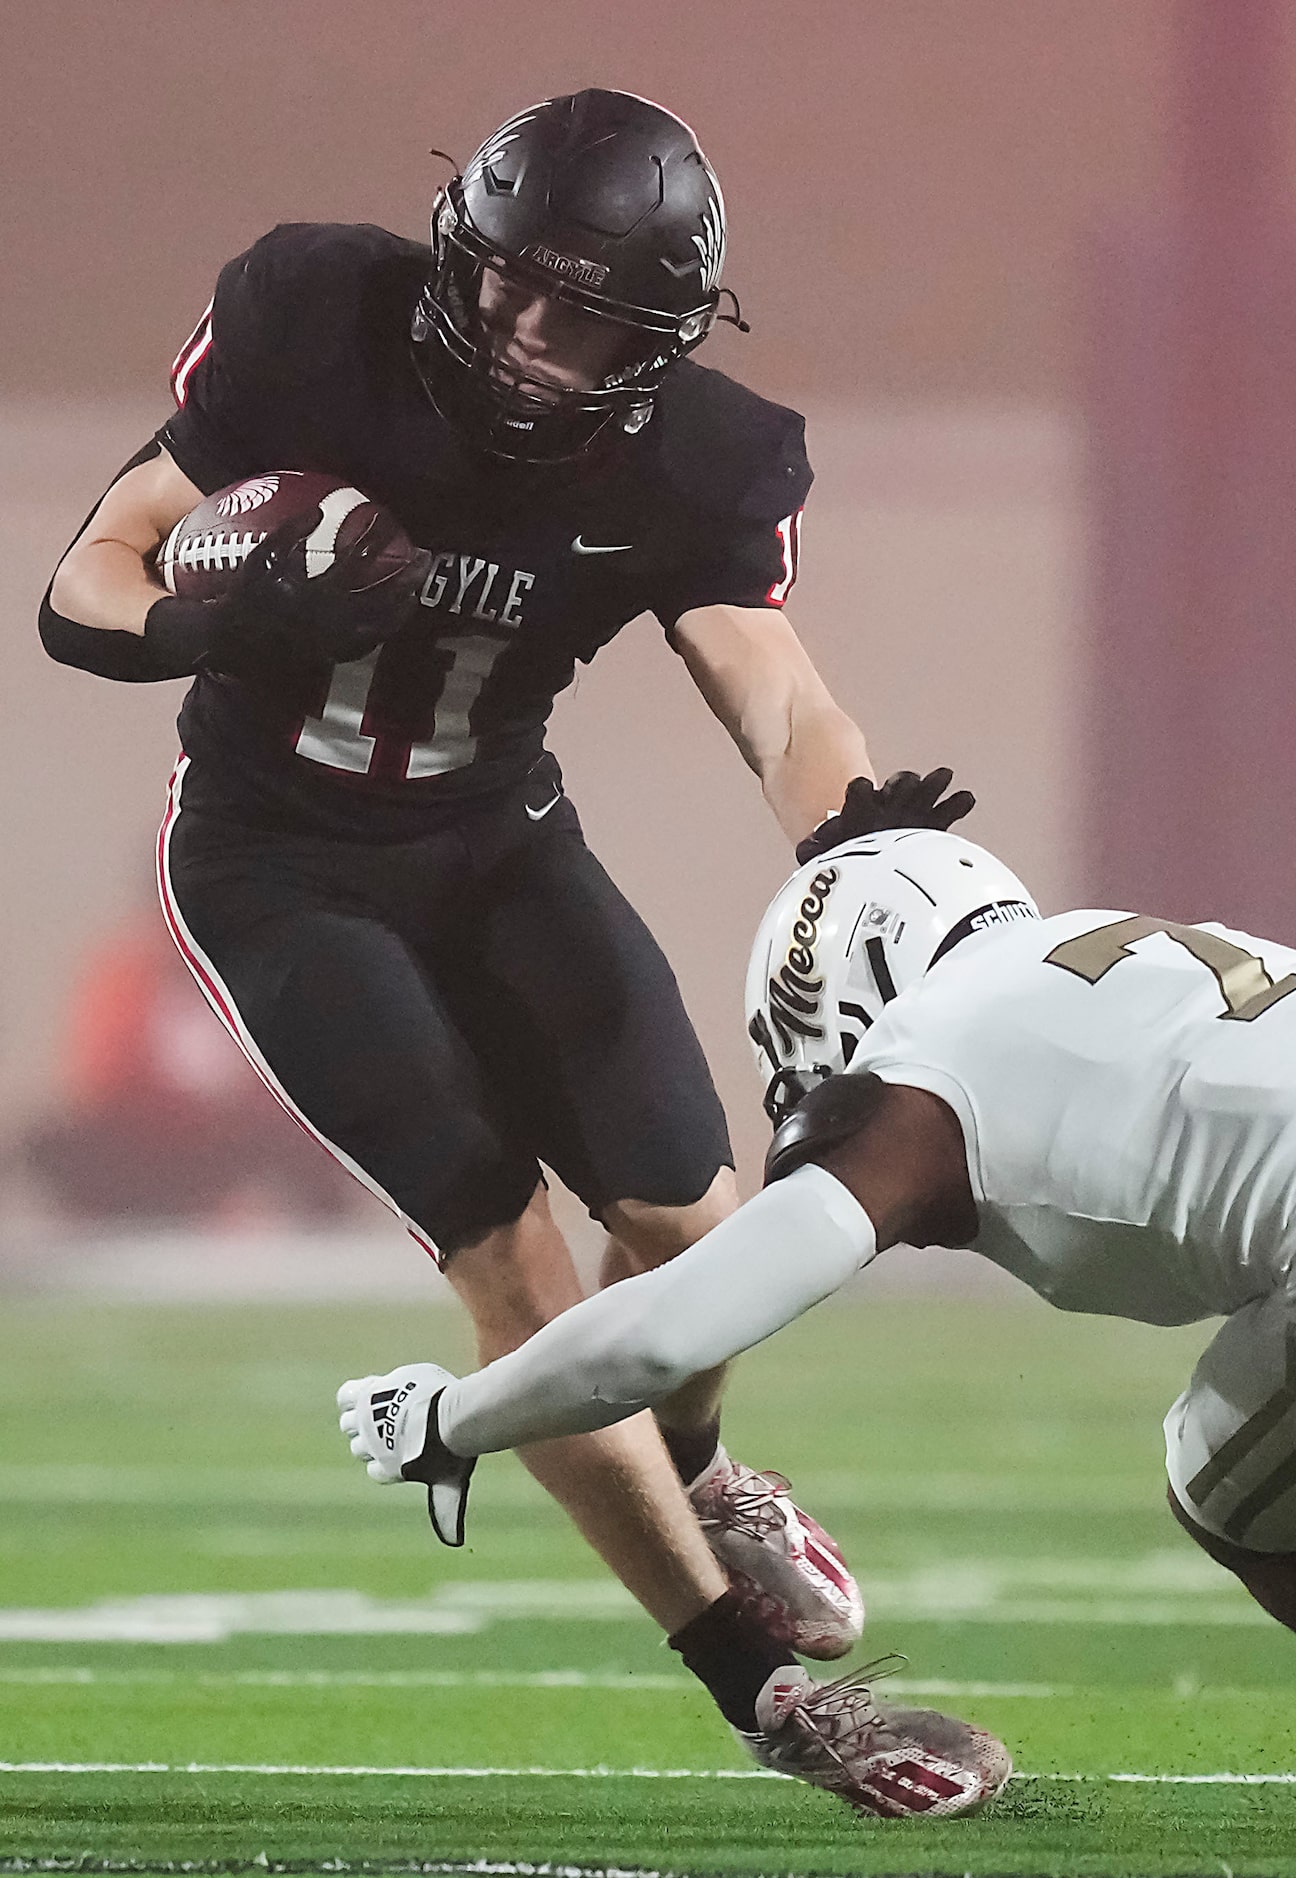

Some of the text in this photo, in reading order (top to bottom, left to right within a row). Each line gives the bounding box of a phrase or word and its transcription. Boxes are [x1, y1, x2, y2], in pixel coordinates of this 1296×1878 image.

[532, 245, 606, 290] ARGYLE
[414, 547, 536, 628] GYLE
[295, 634, 511, 779] 11
[768, 865, 839, 1057] Mecca
[383, 1381, 417, 1451] adidas
